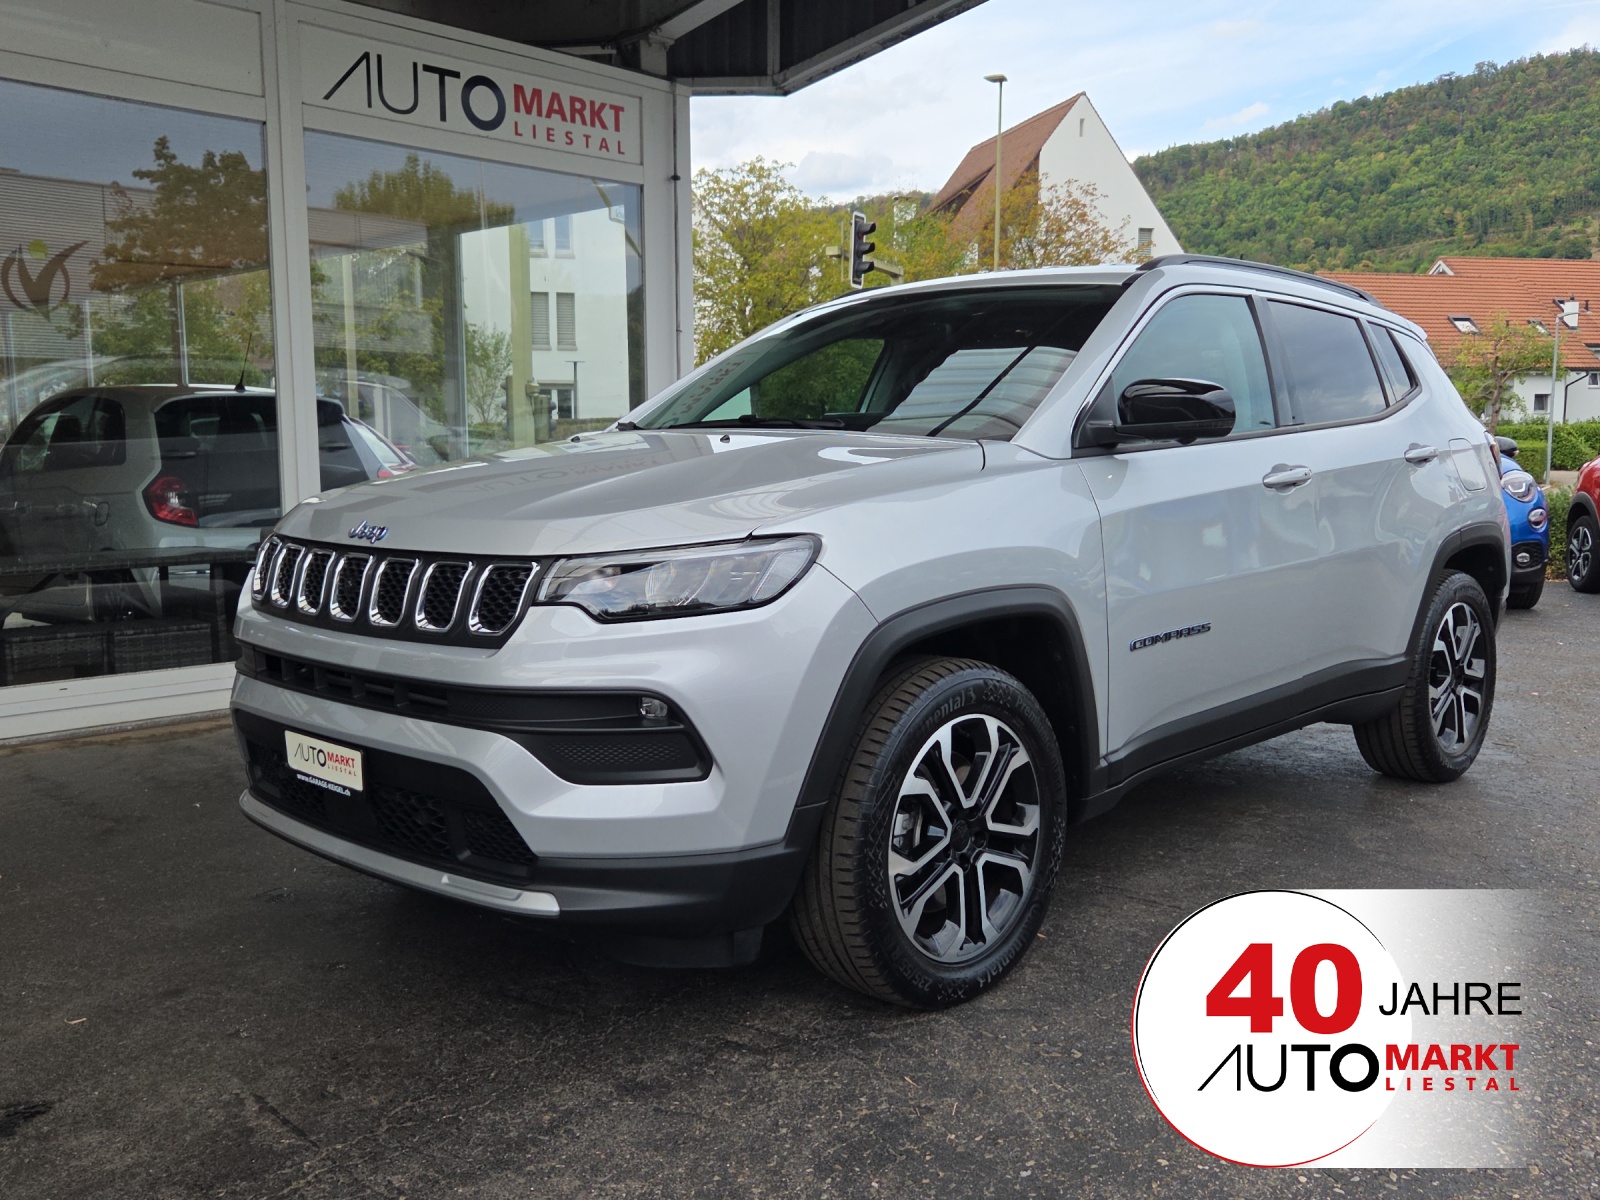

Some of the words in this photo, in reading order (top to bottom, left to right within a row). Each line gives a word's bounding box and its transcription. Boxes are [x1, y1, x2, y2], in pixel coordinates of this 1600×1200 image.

[322, 51, 506, 131] AUTO
[513, 83, 625, 133] MARKT
[514, 121, 625, 155] LIESTAL
[348, 520, 388, 544] Jeep
[1129, 621, 1212, 651] COMPASS
[327, 751, 355, 768] MARKT
[327, 764, 357, 776] LIESTAL
